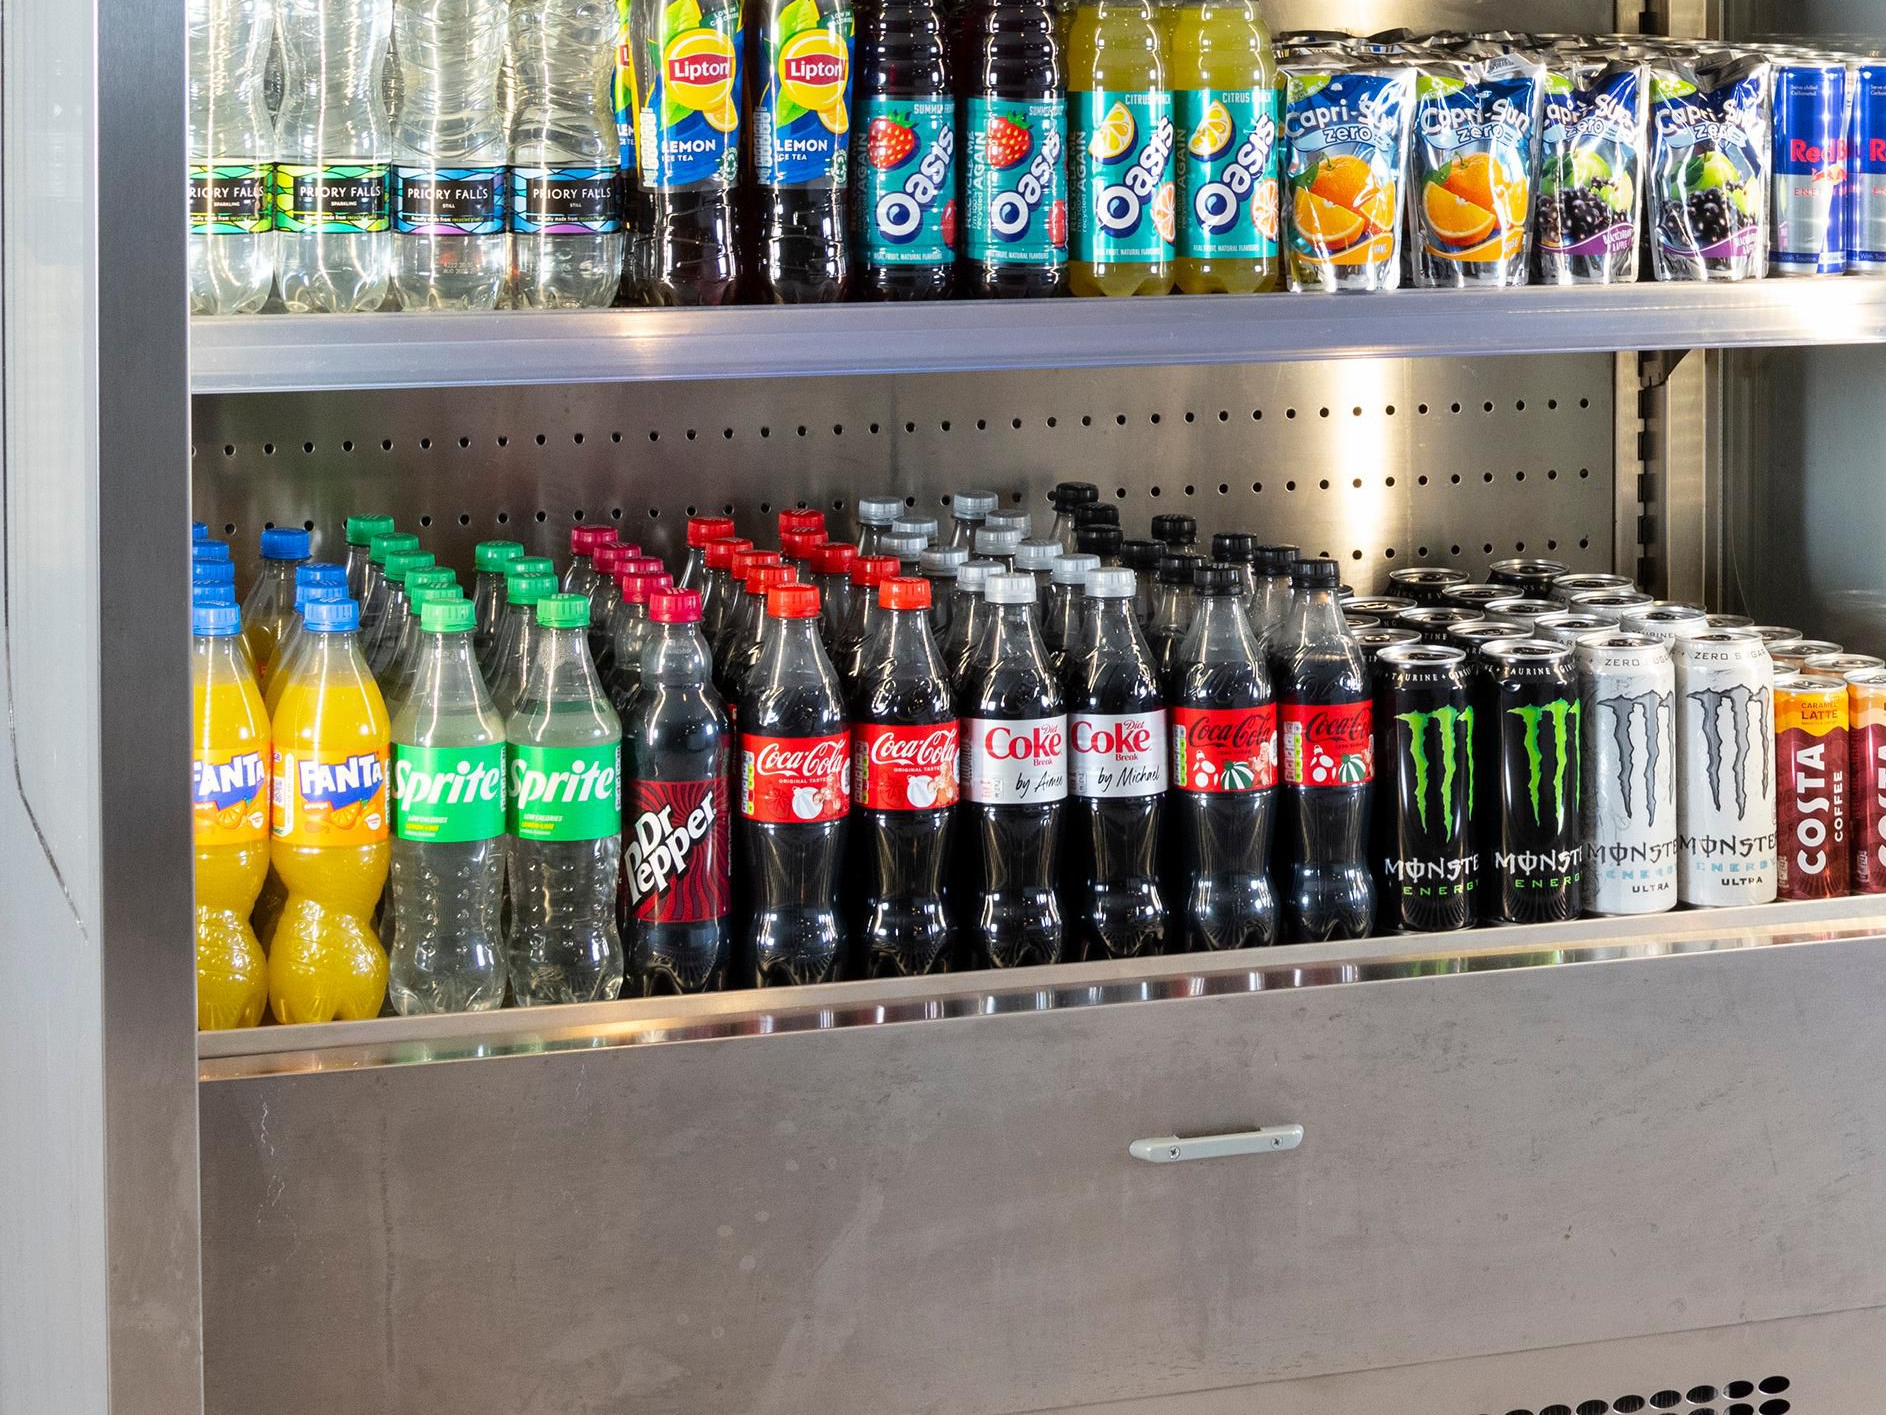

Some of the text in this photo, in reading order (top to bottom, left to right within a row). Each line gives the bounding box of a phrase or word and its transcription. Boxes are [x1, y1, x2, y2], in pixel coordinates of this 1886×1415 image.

[674, 61, 730, 80] Lipton
[791, 61, 842, 79] Lipton
[1222, 92, 1250, 103] CITRUS
[661, 139, 716, 153] LEMON
[776, 139, 828, 152] LEMON
[876, 125, 954, 236] Oasis
[1195, 112, 1275, 227] Oasis
[351, 186, 381, 197] FALLS
[408, 188, 488, 200] PRIORY FALLS
[533, 188, 611, 200] PRIORY FALLS
[1189, 713, 1270, 748] Coca-Cola
[1801, 710, 1837, 720] LATTE
[872, 728, 957, 765] Coca-Cola
[985, 727, 1062, 760] Coke
[1071, 720, 1151, 754] Coke
[299, 753, 383, 794] FANTA
[757, 739, 845, 777] Coca-Cola
[391, 759, 500, 811] Sprite
[509, 759, 614, 810] Sprite
[1098, 764, 1160, 789] by Michael
[1797, 743, 1829, 874] COSTA
[1833, 771, 1843, 842] COFFEE
[635, 804, 673, 859] Dr
[624, 791, 715, 906] Pepper
[1633, 884, 1669, 893] ULTRA
[1722, 878, 1763, 886] ULTRA
